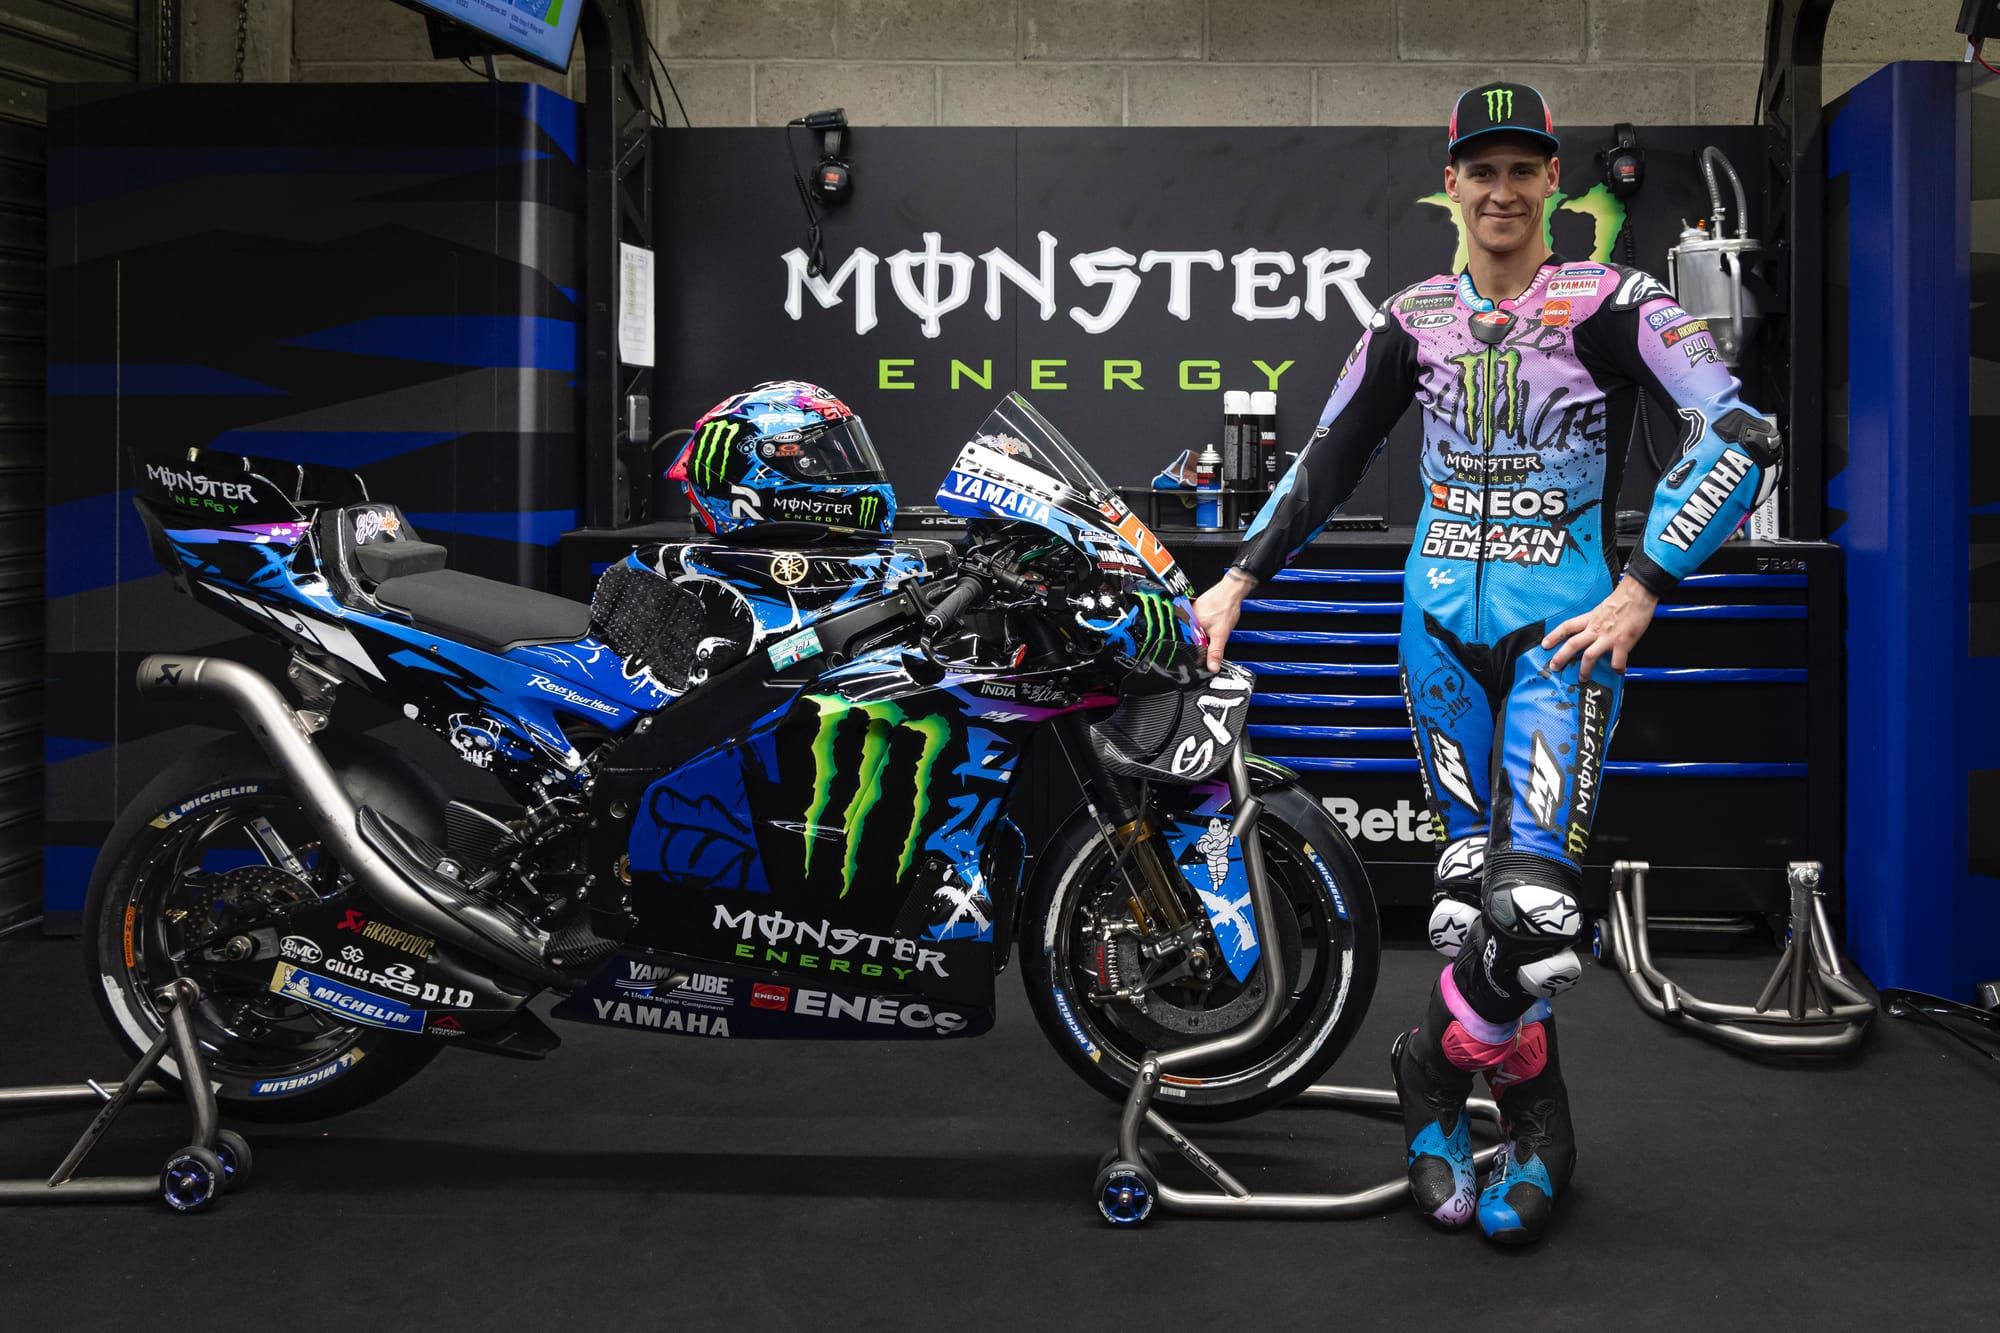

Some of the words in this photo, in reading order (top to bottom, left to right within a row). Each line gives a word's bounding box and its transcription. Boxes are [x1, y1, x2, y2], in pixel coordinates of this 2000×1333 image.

[781, 231, 1374, 338] MONSTER
[1415, 296, 1454, 305] MONSTER
[1512, 268, 1553, 306] YAMAHA
[1560, 280, 1597, 290] YAMAHA
[1416, 315, 1450, 326] HJC
[878, 359, 1296, 391] ENERGY
[1446, 453, 1542, 472] MONSTER
[145, 463, 260, 505] MONSTER
[953, 472, 1051, 526] YAMAHA
[1660, 449, 1754, 552] YAMAHA
[173, 495, 240, 515] NERGY
[773, 497, 854, 516] MONSTER
[784, 512, 841, 523] ENERGY
[1447, 486, 1566, 518] ENEOS
[527, 673, 569, 697] Revs
[589, 699, 620, 717] Heart
[980, 683, 1017, 698] INDIA
[1400, 672, 1432, 799] MONSTER
[1576, 688, 1602, 815] MONSTER
[180, 785, 258, 814] MICHELIN
[1322, 797, 1437, 843] Beta
[1315, 861, 1346, 914] MICHELIN
[283, 938, 320, 961] BMC
[712, 904, 950, 978] MONSTER
[325, 957, 370, 982] GILLES
[628, 960, 729, 996] YAMLUBE
[735, 943, 915, 980] ENERGY
[369, 973, 422, 997] RCB
[754, 992, 785, 1002] ENEOS
[313, 986, 411, 1025] MICHELIN
[593, 998, 730, 1038] YAMAHA
[681, 1000, 724, 1012] Component
[794, 989, 968, 1035] ENEOS
[1055, 993, 1088, 1045] MICHELIN
[258, 1063, 338, 1093] MICHELIN
